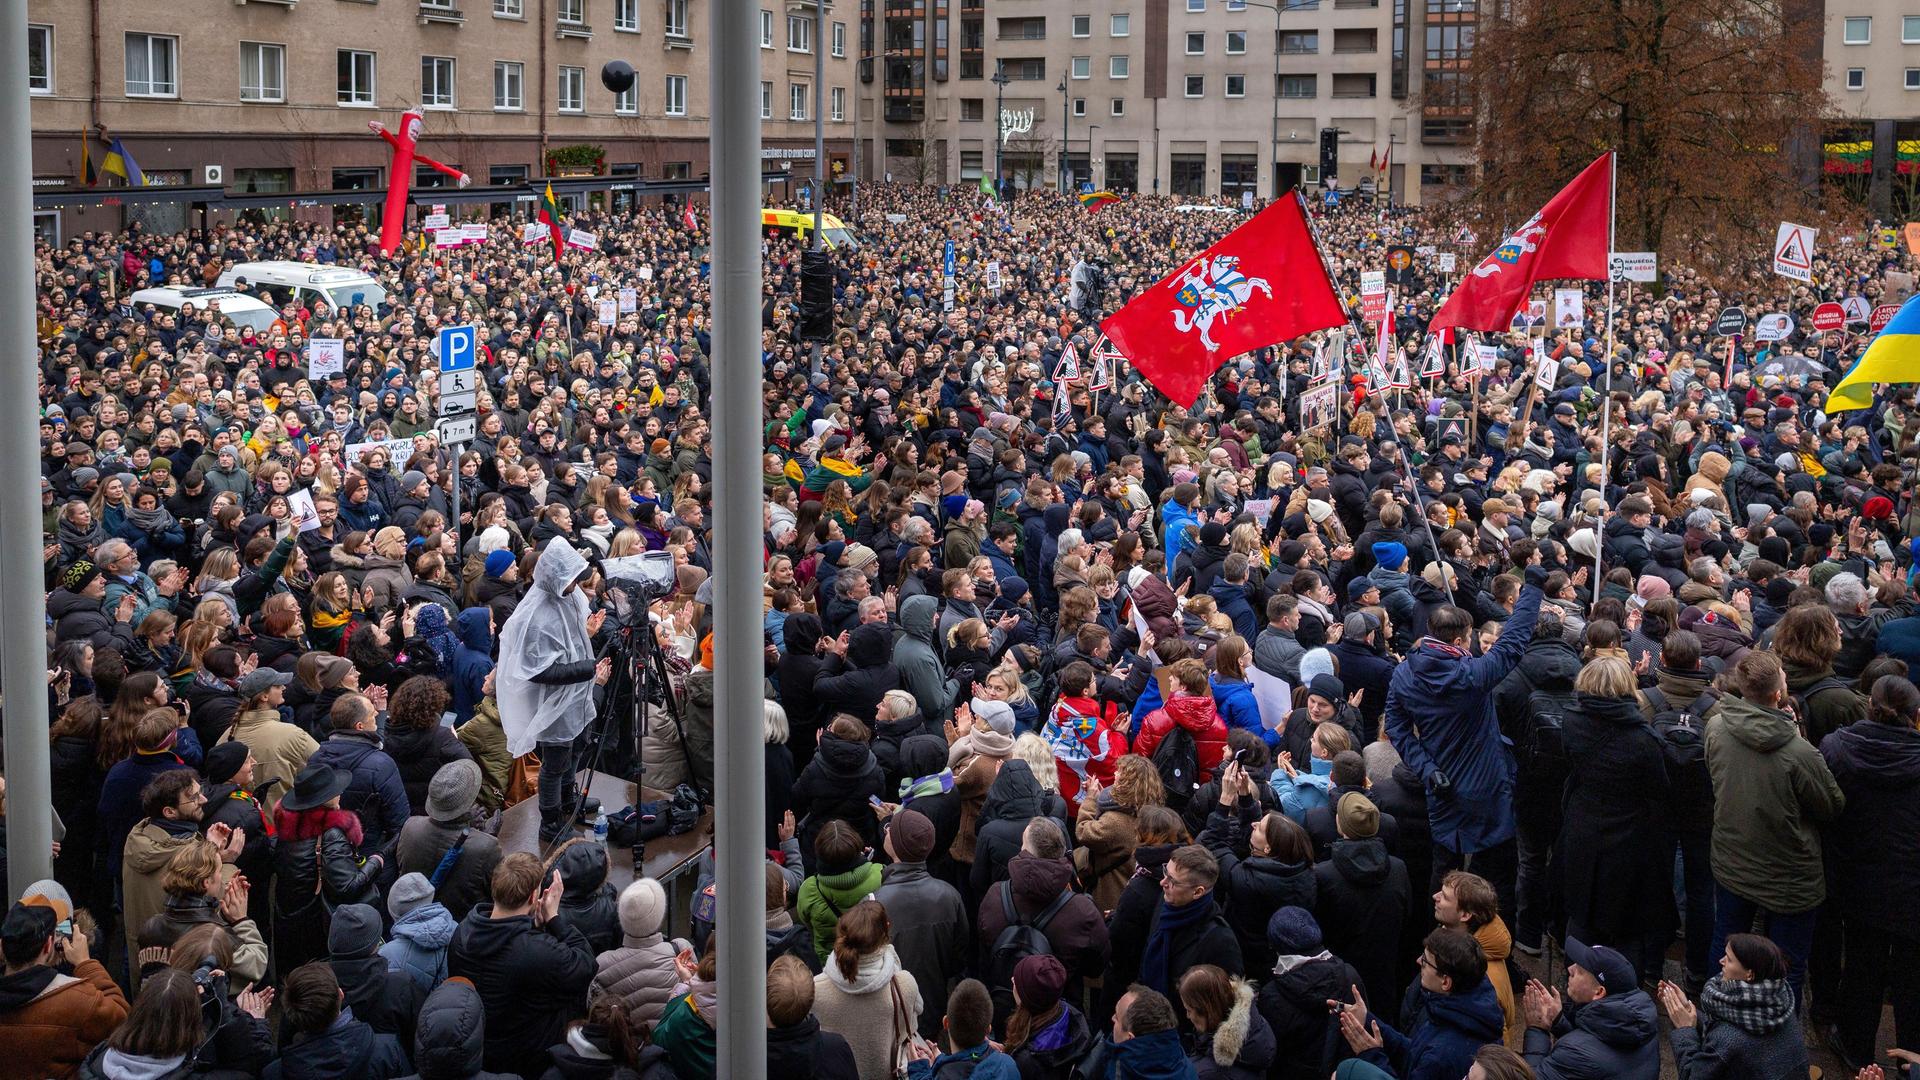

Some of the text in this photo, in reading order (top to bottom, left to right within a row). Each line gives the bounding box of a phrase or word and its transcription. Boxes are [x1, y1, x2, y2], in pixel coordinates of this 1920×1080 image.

[948, 243, 953, 260] P
[1776, 263, 1809, 279] ŠIAULIAI
[450, 332, 469, 367] P
[452, 427, 466, 436] 7 m
